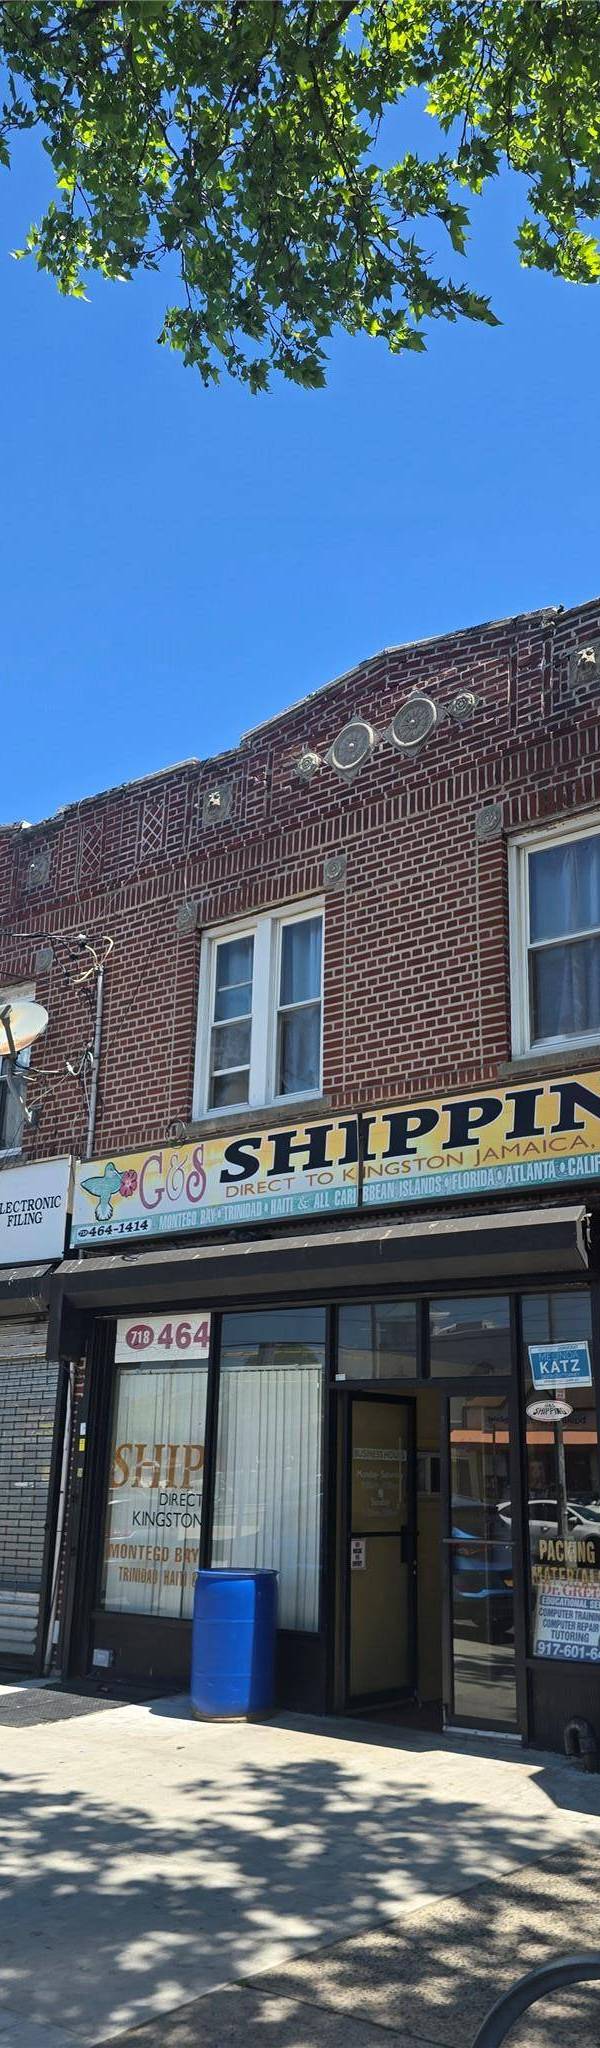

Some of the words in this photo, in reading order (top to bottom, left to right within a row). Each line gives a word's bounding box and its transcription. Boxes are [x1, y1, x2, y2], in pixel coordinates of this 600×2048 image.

[226, 1177, 295, 1198] DIRECT
[305, 1172, 334, 1186] TO
[343, 1152, 463, 1182] KINGSTON
[474, 1135, 596, 1167] JAMAICA,
[138, 1144, 206, 1209] G&S
[0, 1195, 61, 1214] LECTRONIC
[159, 1211, 197, 1230] MONTEGO
[200, 1206, 216, 1224] BAY
[224, 1201, 262, 1220] TRINIDAD
[270, 1197, 294, 1215] HAITI
[298, 1195, 310, 1210] &
[313, 1190, 330, 1208] ALL
[334, 1181, 395, 1206] CARIBBEAN
[400, 1175, 440, 1196] ISLANDS
[453, 1167, 495, 1190] FLORIDA
[506, 1161, 556, 1182] ATLANTA
[7, 1211, 43, 1227] FILING
[89, 1219, 149, 1237] 464-1414
[131, 1330, 151, 1345] 718
[157, 1321, 211, 1349] 464
[540, 1359, 580, 1374] KATZ
[110, 1443, 205, 1489] SHIP
[160, 1492, 203, 1508] DIRECT
[132, 1510, 204, 1529] KINGSTON
[106, 1543, 169, 1562] MONTEGO
[175, 1547, 200, 1563] BAY
[539, 1540, 595, 1564] PACKING
[119, 1566, 159, 1585] TRINIDAD
[164, 1570, 188, 1587] HAITI
[542, 1596, 587, 1608] EDUCATIONAL
[539, 1608, 573, 1619] COMPUTER
[543, 1619, 575, 1630] COMPUTER
[551, 1630, 589, 1643] TUTORING
